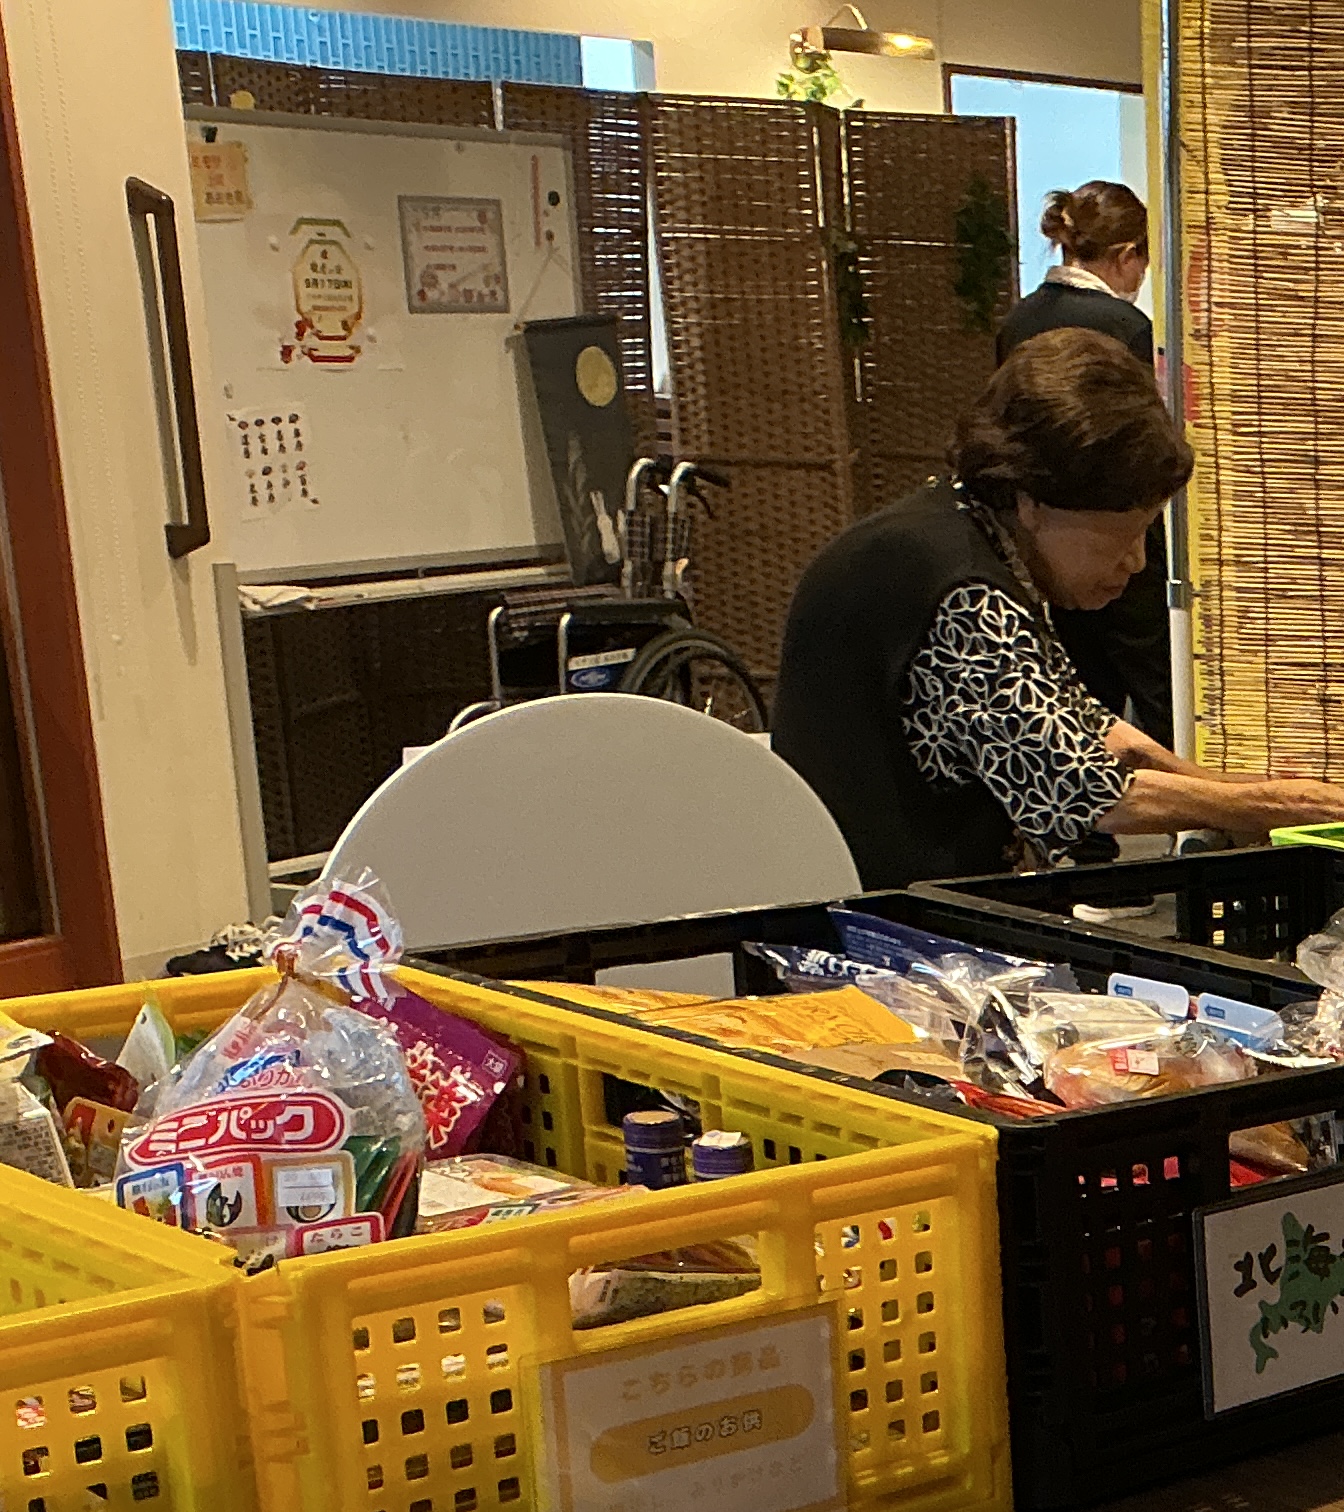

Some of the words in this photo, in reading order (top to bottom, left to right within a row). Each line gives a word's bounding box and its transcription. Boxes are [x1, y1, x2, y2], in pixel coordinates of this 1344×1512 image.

[148, 1103, 316, 1153] ミニパック
